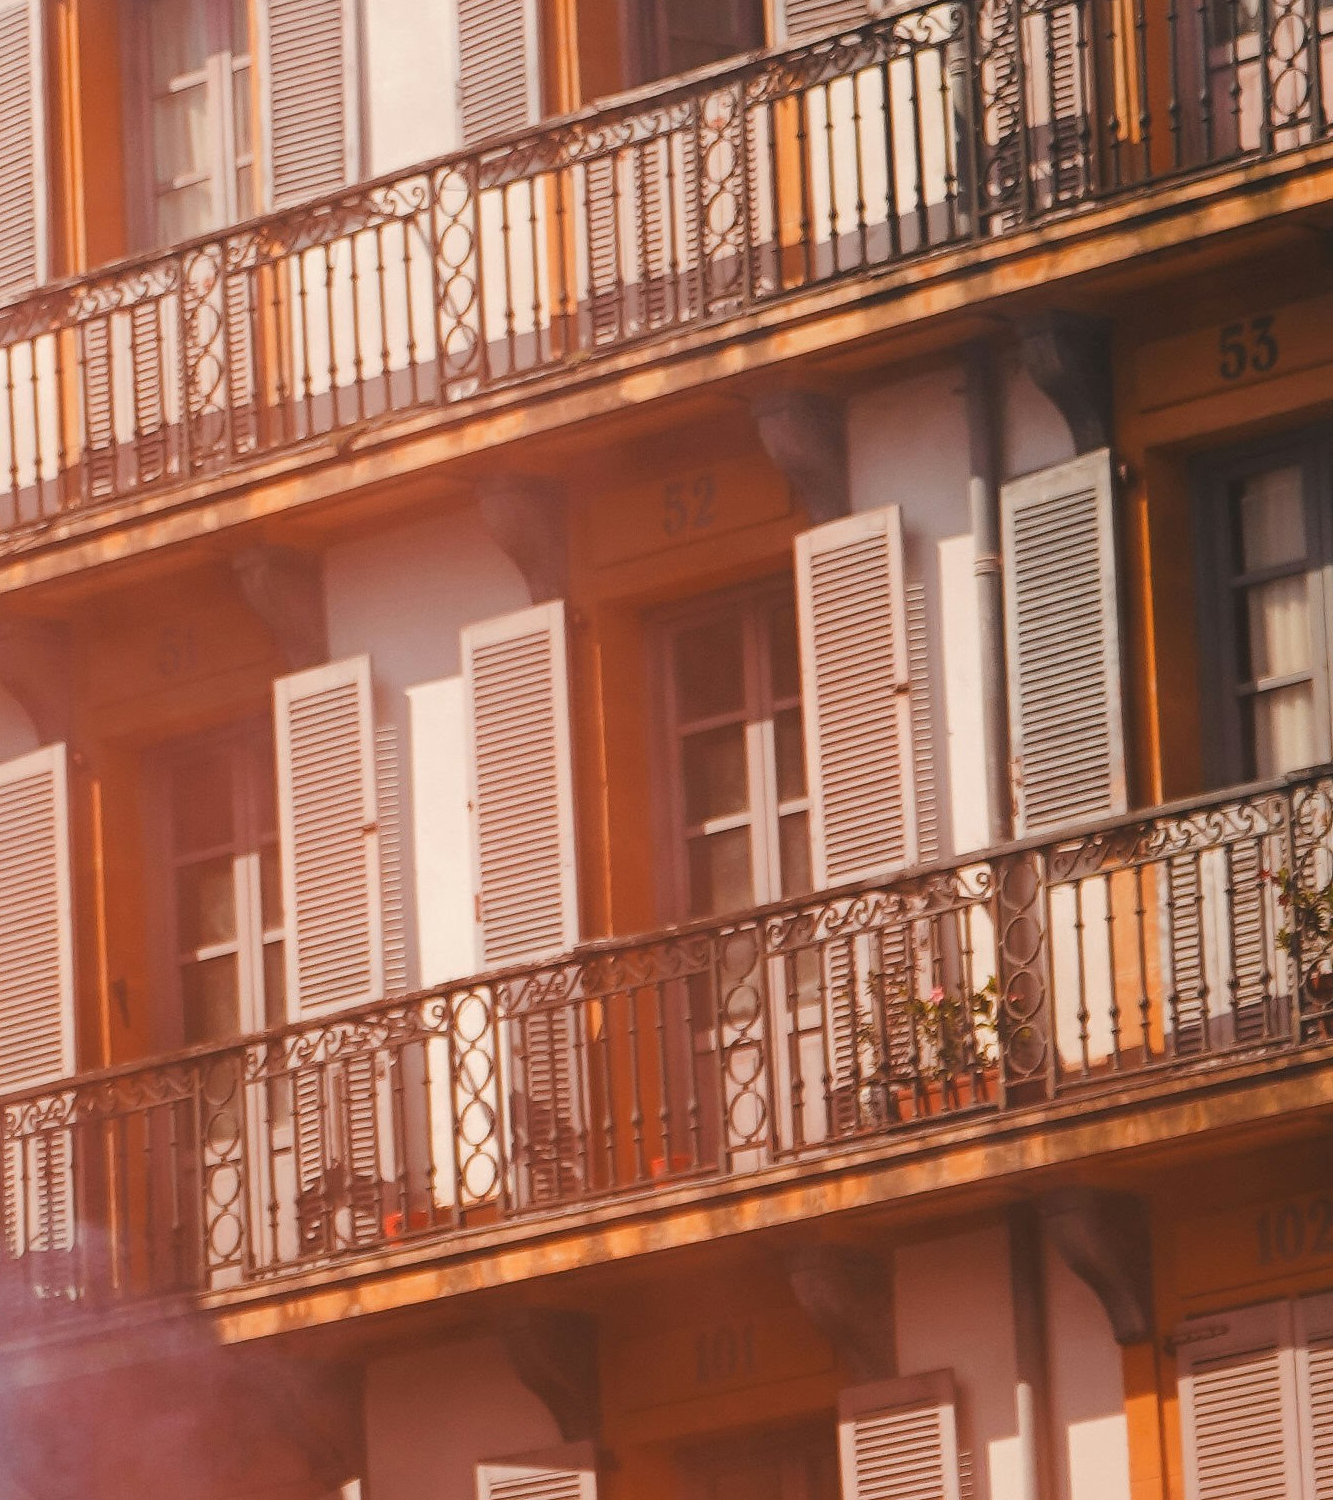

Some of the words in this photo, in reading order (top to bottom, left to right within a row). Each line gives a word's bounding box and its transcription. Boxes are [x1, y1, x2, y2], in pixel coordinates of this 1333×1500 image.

[1219, 315, 1279, 381] 53
[662, 472, 719, 538] 52
[1254, 1196, 1333, 1268] 102
[693, 1315, 755, 1385] 101
